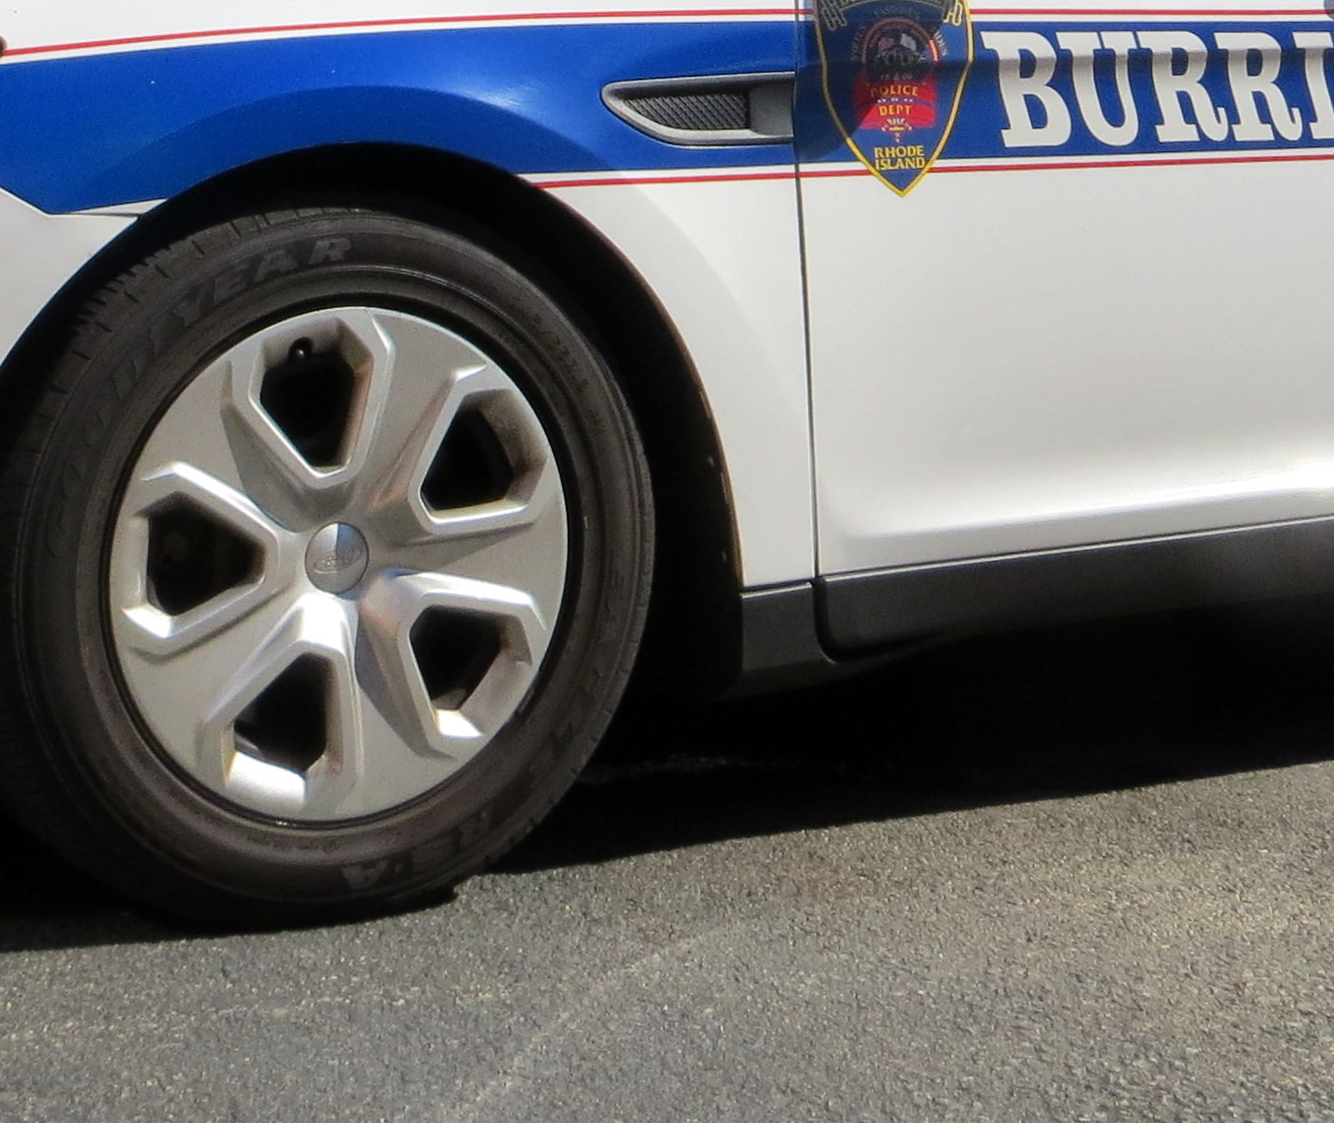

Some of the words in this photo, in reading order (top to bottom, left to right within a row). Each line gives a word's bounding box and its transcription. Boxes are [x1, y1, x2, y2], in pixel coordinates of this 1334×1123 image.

[870, 84, 918, 97] POLICE
[878, 103, 913, 116] DEPT
[874, 145, 925, 158] RHODE
[875, 157, 926, 170] ISLAND
